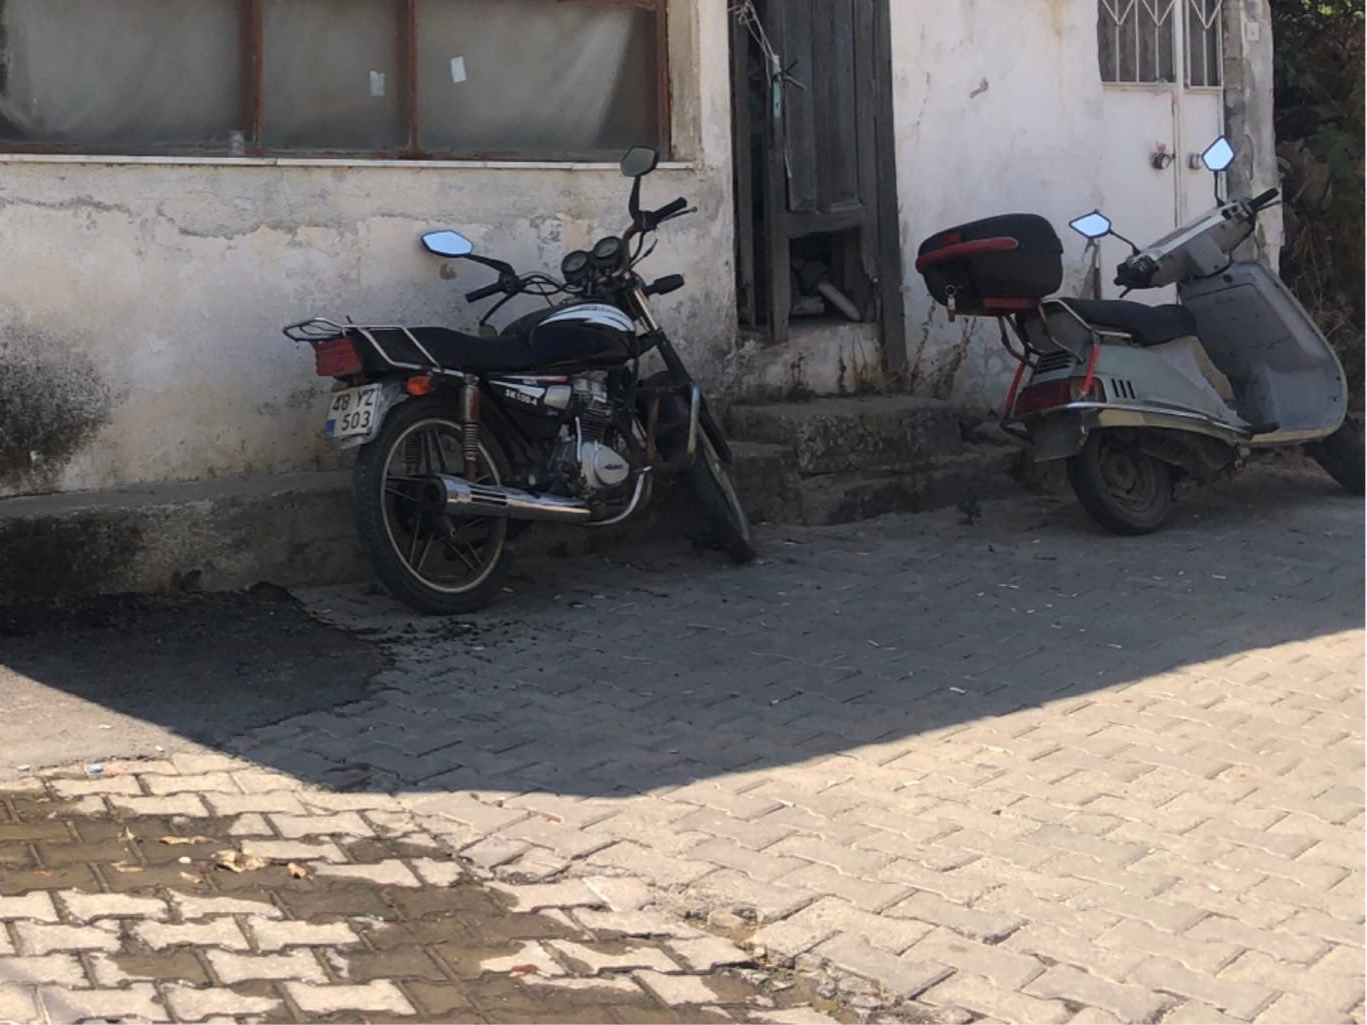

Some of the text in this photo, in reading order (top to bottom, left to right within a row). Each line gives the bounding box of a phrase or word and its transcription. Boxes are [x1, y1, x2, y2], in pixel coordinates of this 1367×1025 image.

[332, 388, 376, 411] 48 YZ
[341, 410, 371, 431] 503
